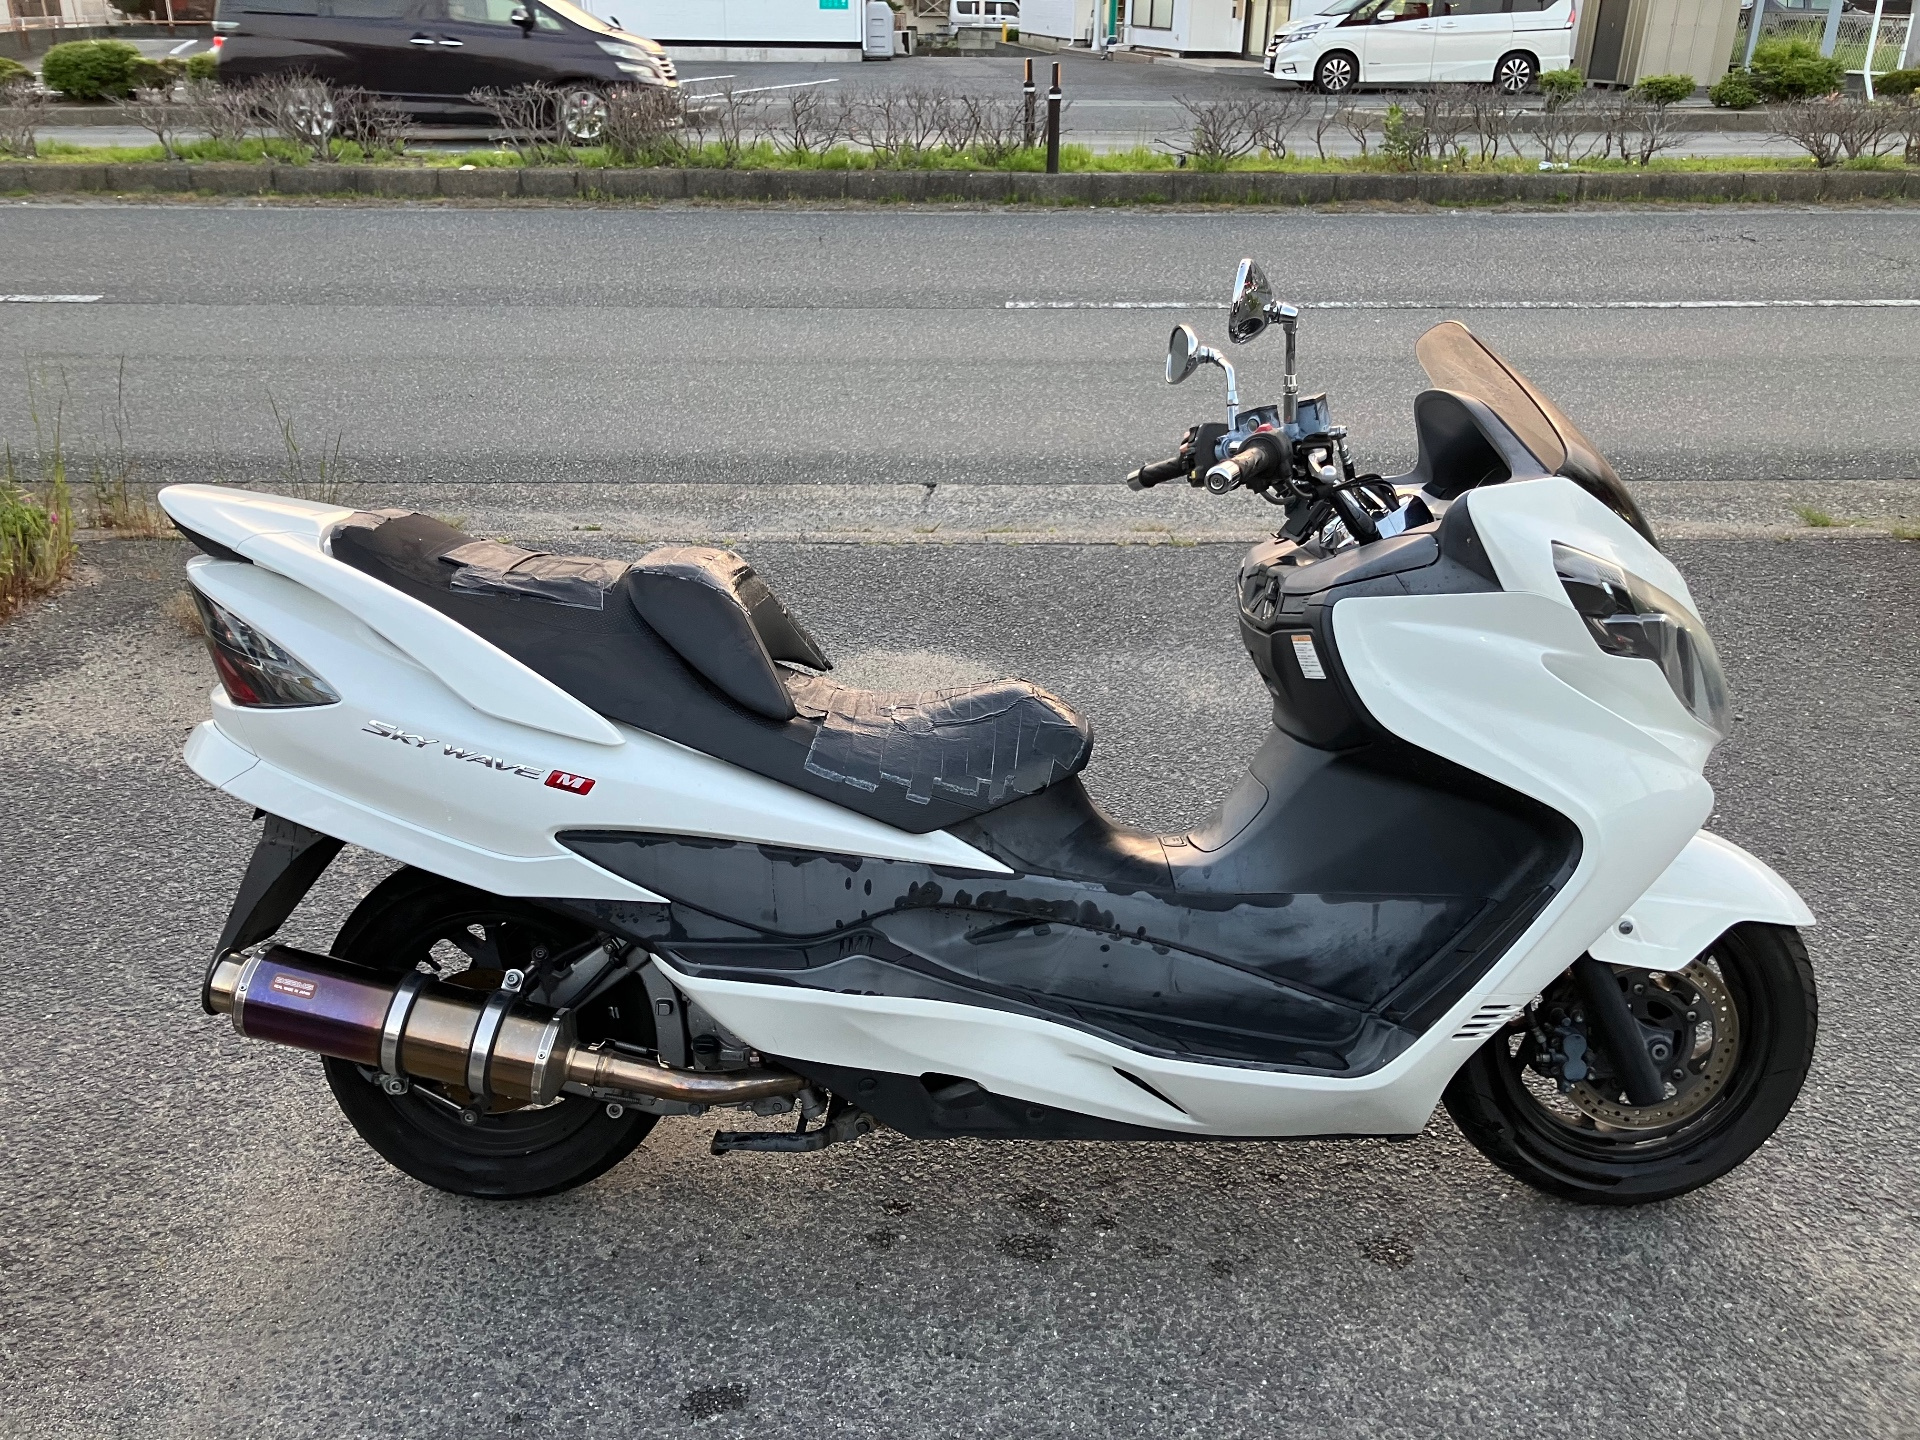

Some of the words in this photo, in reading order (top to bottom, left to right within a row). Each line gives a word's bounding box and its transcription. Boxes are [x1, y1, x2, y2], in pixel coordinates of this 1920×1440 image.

[361, 719, 440, 748] SKY
[443, 743, 546, 780] WAVE
[556, 774, 586, 789] M
